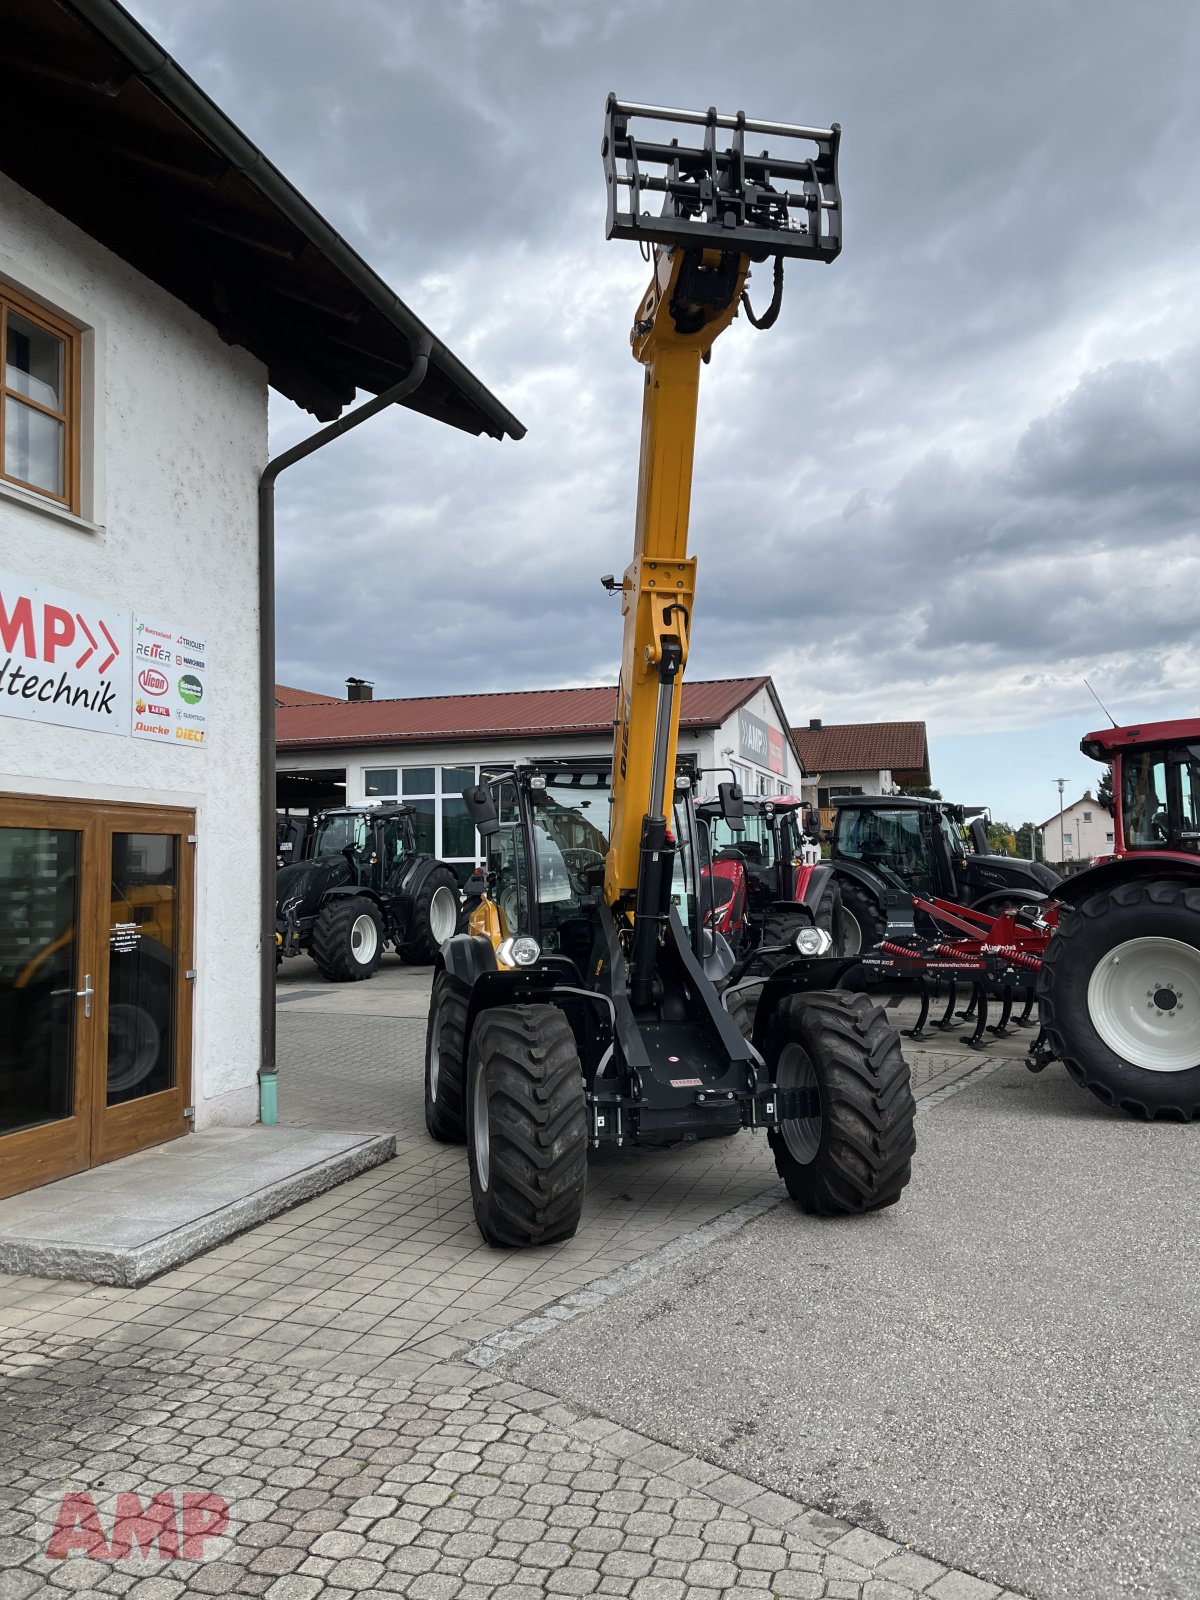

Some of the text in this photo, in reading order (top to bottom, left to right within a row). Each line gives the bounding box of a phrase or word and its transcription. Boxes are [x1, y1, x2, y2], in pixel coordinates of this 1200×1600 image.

[136, 643, 171, 662] REITER
[142, 669, 166, 690] Vicon
[135, 721, 170, 736] Quicke
